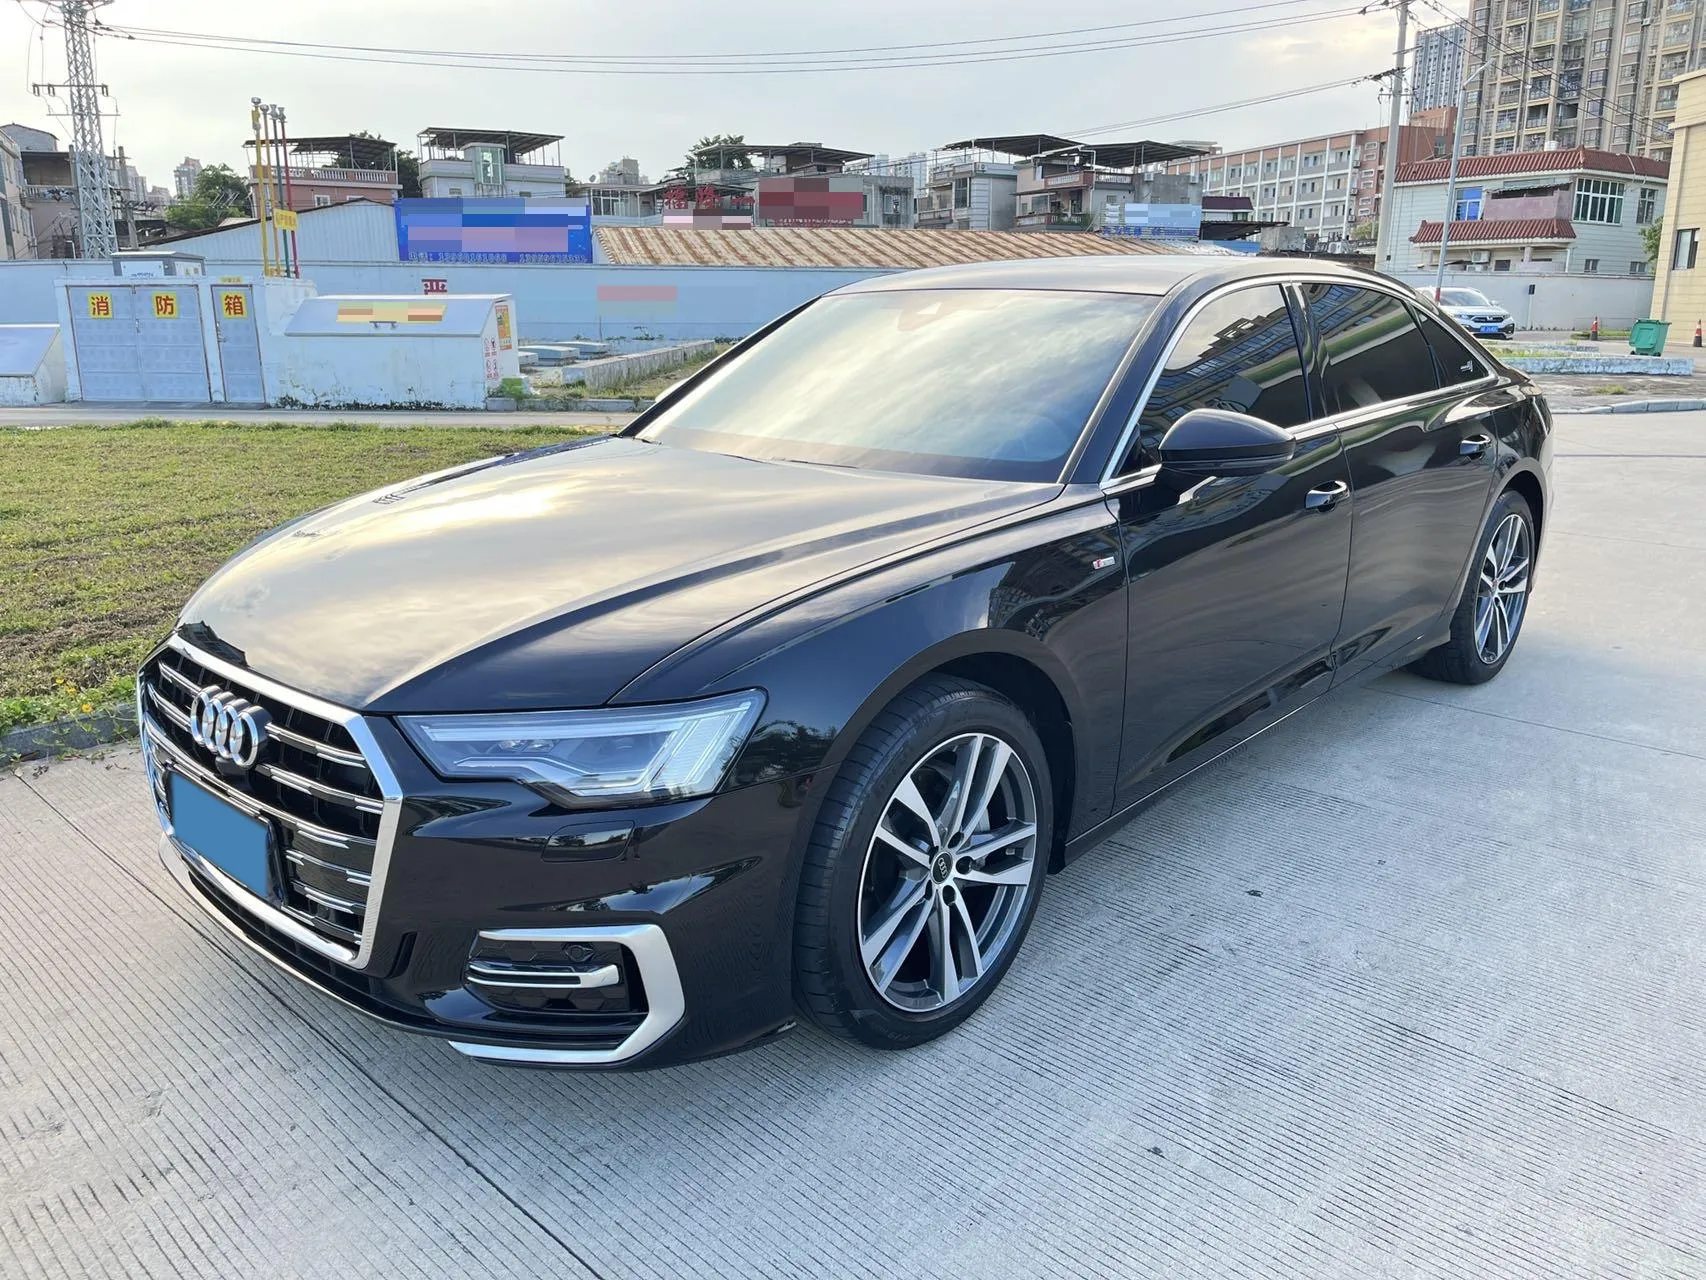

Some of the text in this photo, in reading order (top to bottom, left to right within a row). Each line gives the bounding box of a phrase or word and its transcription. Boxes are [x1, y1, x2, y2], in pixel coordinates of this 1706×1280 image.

[91, 295, 244, 316] 消 防 箱
